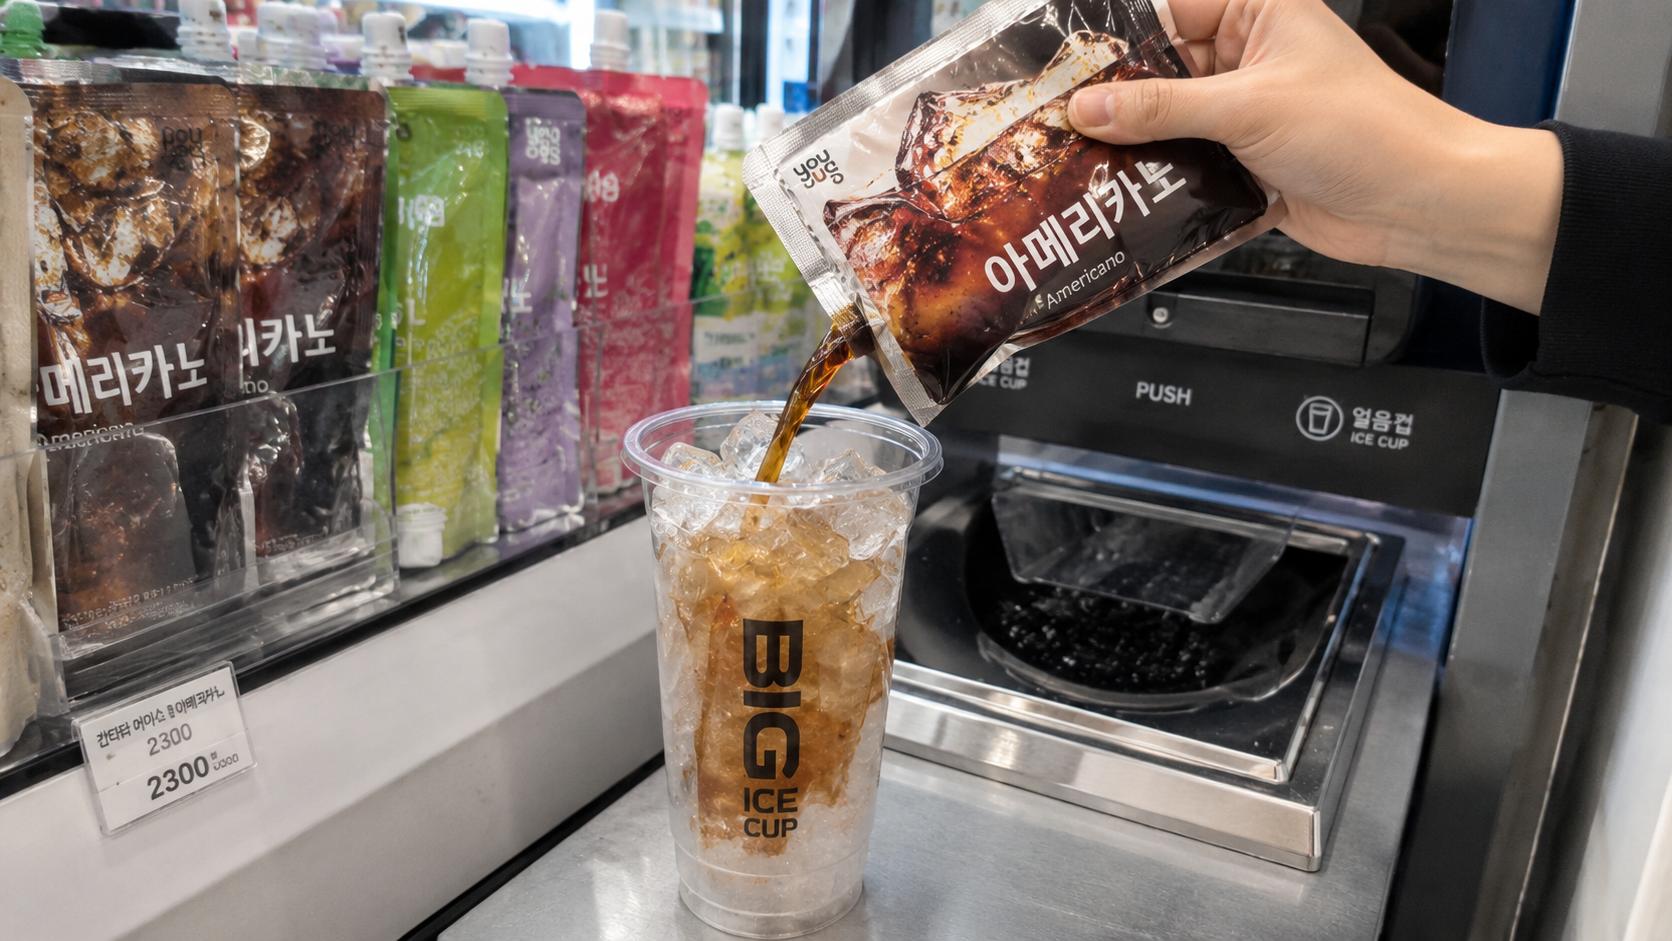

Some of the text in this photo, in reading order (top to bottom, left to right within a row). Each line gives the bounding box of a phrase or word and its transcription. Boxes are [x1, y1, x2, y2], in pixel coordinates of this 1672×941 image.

[984, 160, 1187, 293] 아메리카노
[1046, 250, 1126, 310] Americano
[38, 342, 208, 415] 메리카노
[1000, 377, 1028, 389] CUP
[1135, 381, 1192, 406] PUSH
[1350, 431, 1410, 450] ICE CUP
[743, 618, 803, 780] BIG
[146, 722, 193, 757] 2300
[147, 755, 210, 801] 2300
[743, 787, 798, 813] ICE
[743, 817, 798, 838] CUP
